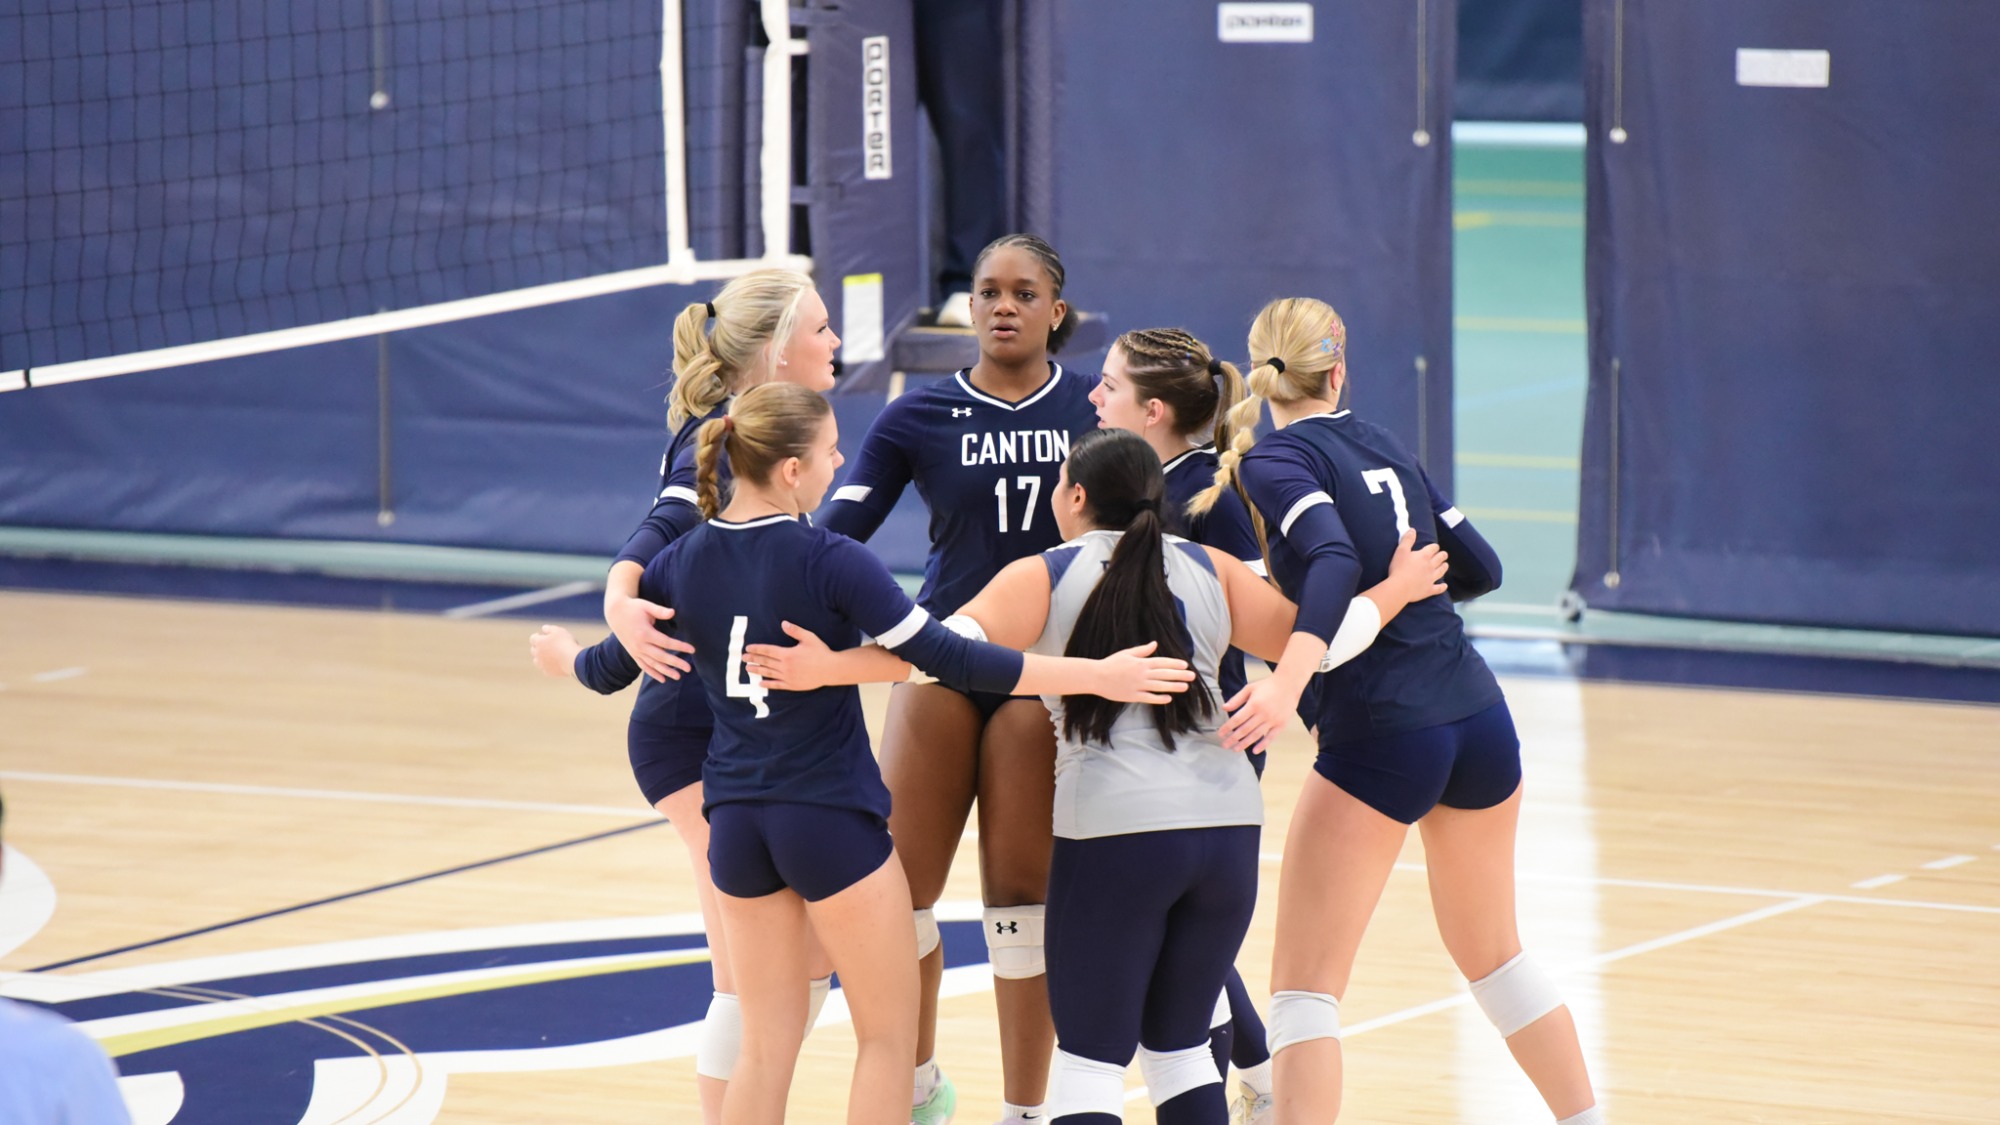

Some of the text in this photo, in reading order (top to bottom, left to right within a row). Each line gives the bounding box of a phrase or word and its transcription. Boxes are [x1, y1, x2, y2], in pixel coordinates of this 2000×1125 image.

[961, 430, 1070, 466] CANTON
[995, 476, 1041, 532] 17
[1361, 467, 1409, 544] 7
[726, 615, 770, 719] 4
